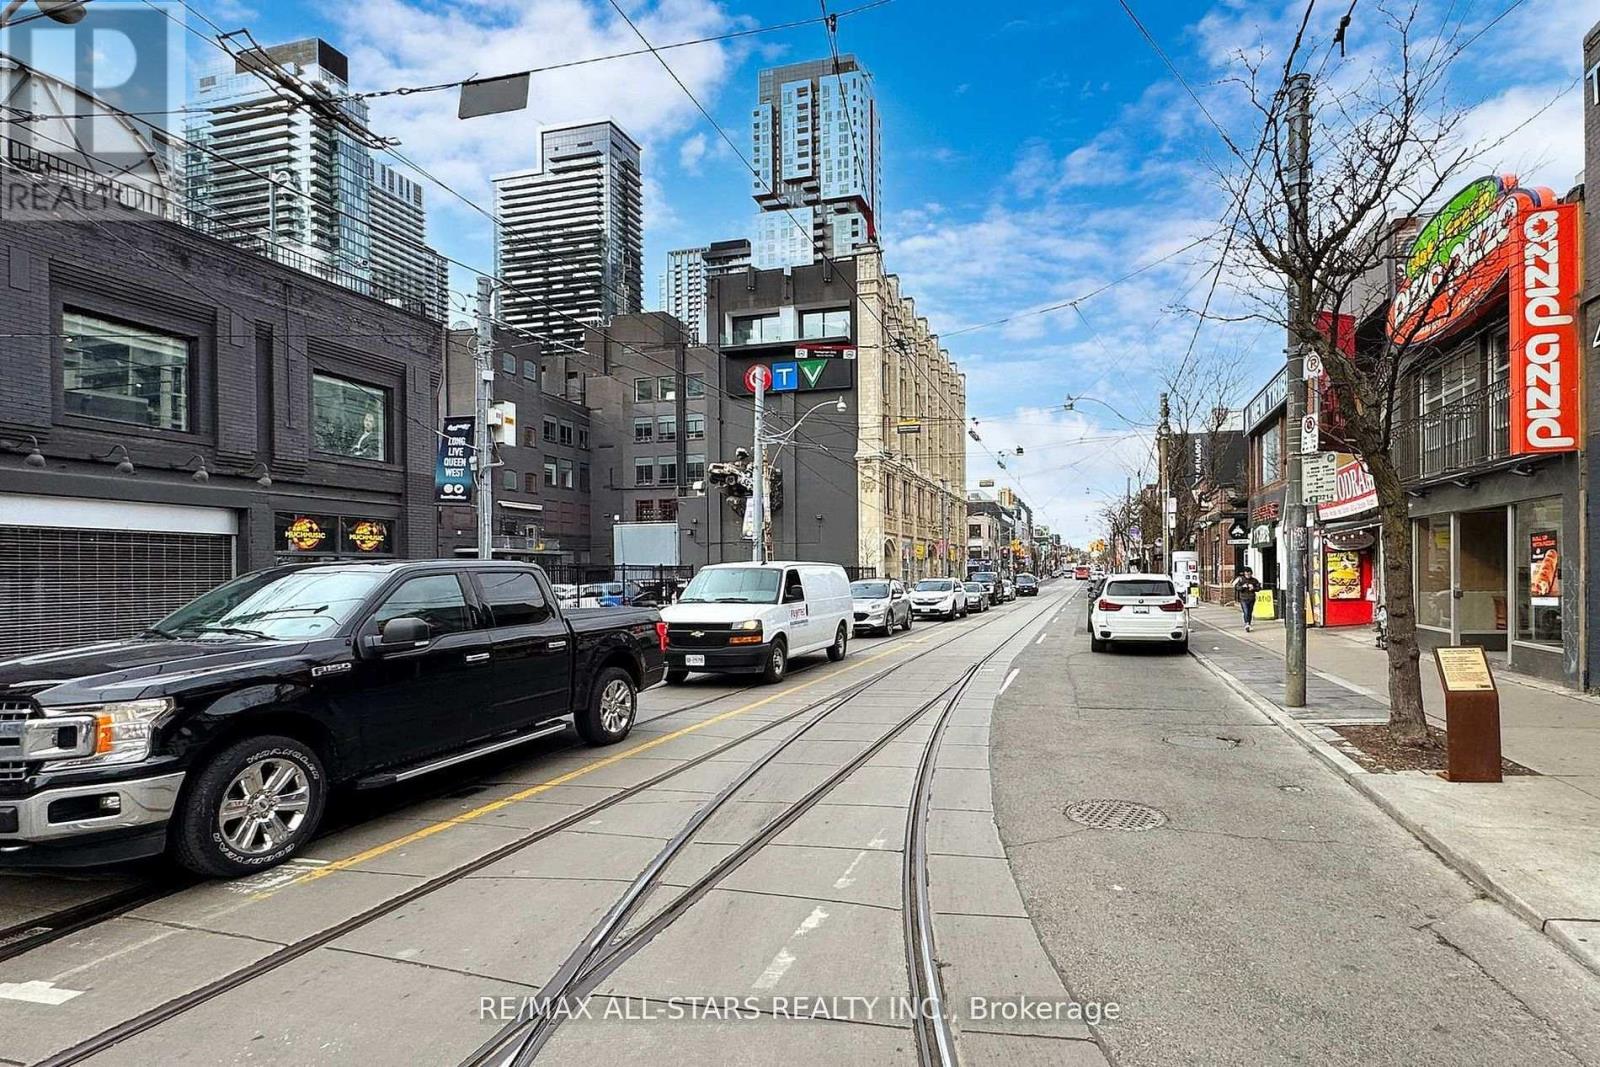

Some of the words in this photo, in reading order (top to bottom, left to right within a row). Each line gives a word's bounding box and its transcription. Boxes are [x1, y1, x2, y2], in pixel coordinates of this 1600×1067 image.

[1524, 210, 1573, 327] pizza
[1526, 333, 1574, 448] pizza
[448, 437, 466, 446] LONG
[448, 448, 464, 456] LIVE
[443, 458, 466, 466] QUEEN
[445, 468, 464, 477] WEST
[285, 531, 326, 539] MUCHMUSIC
